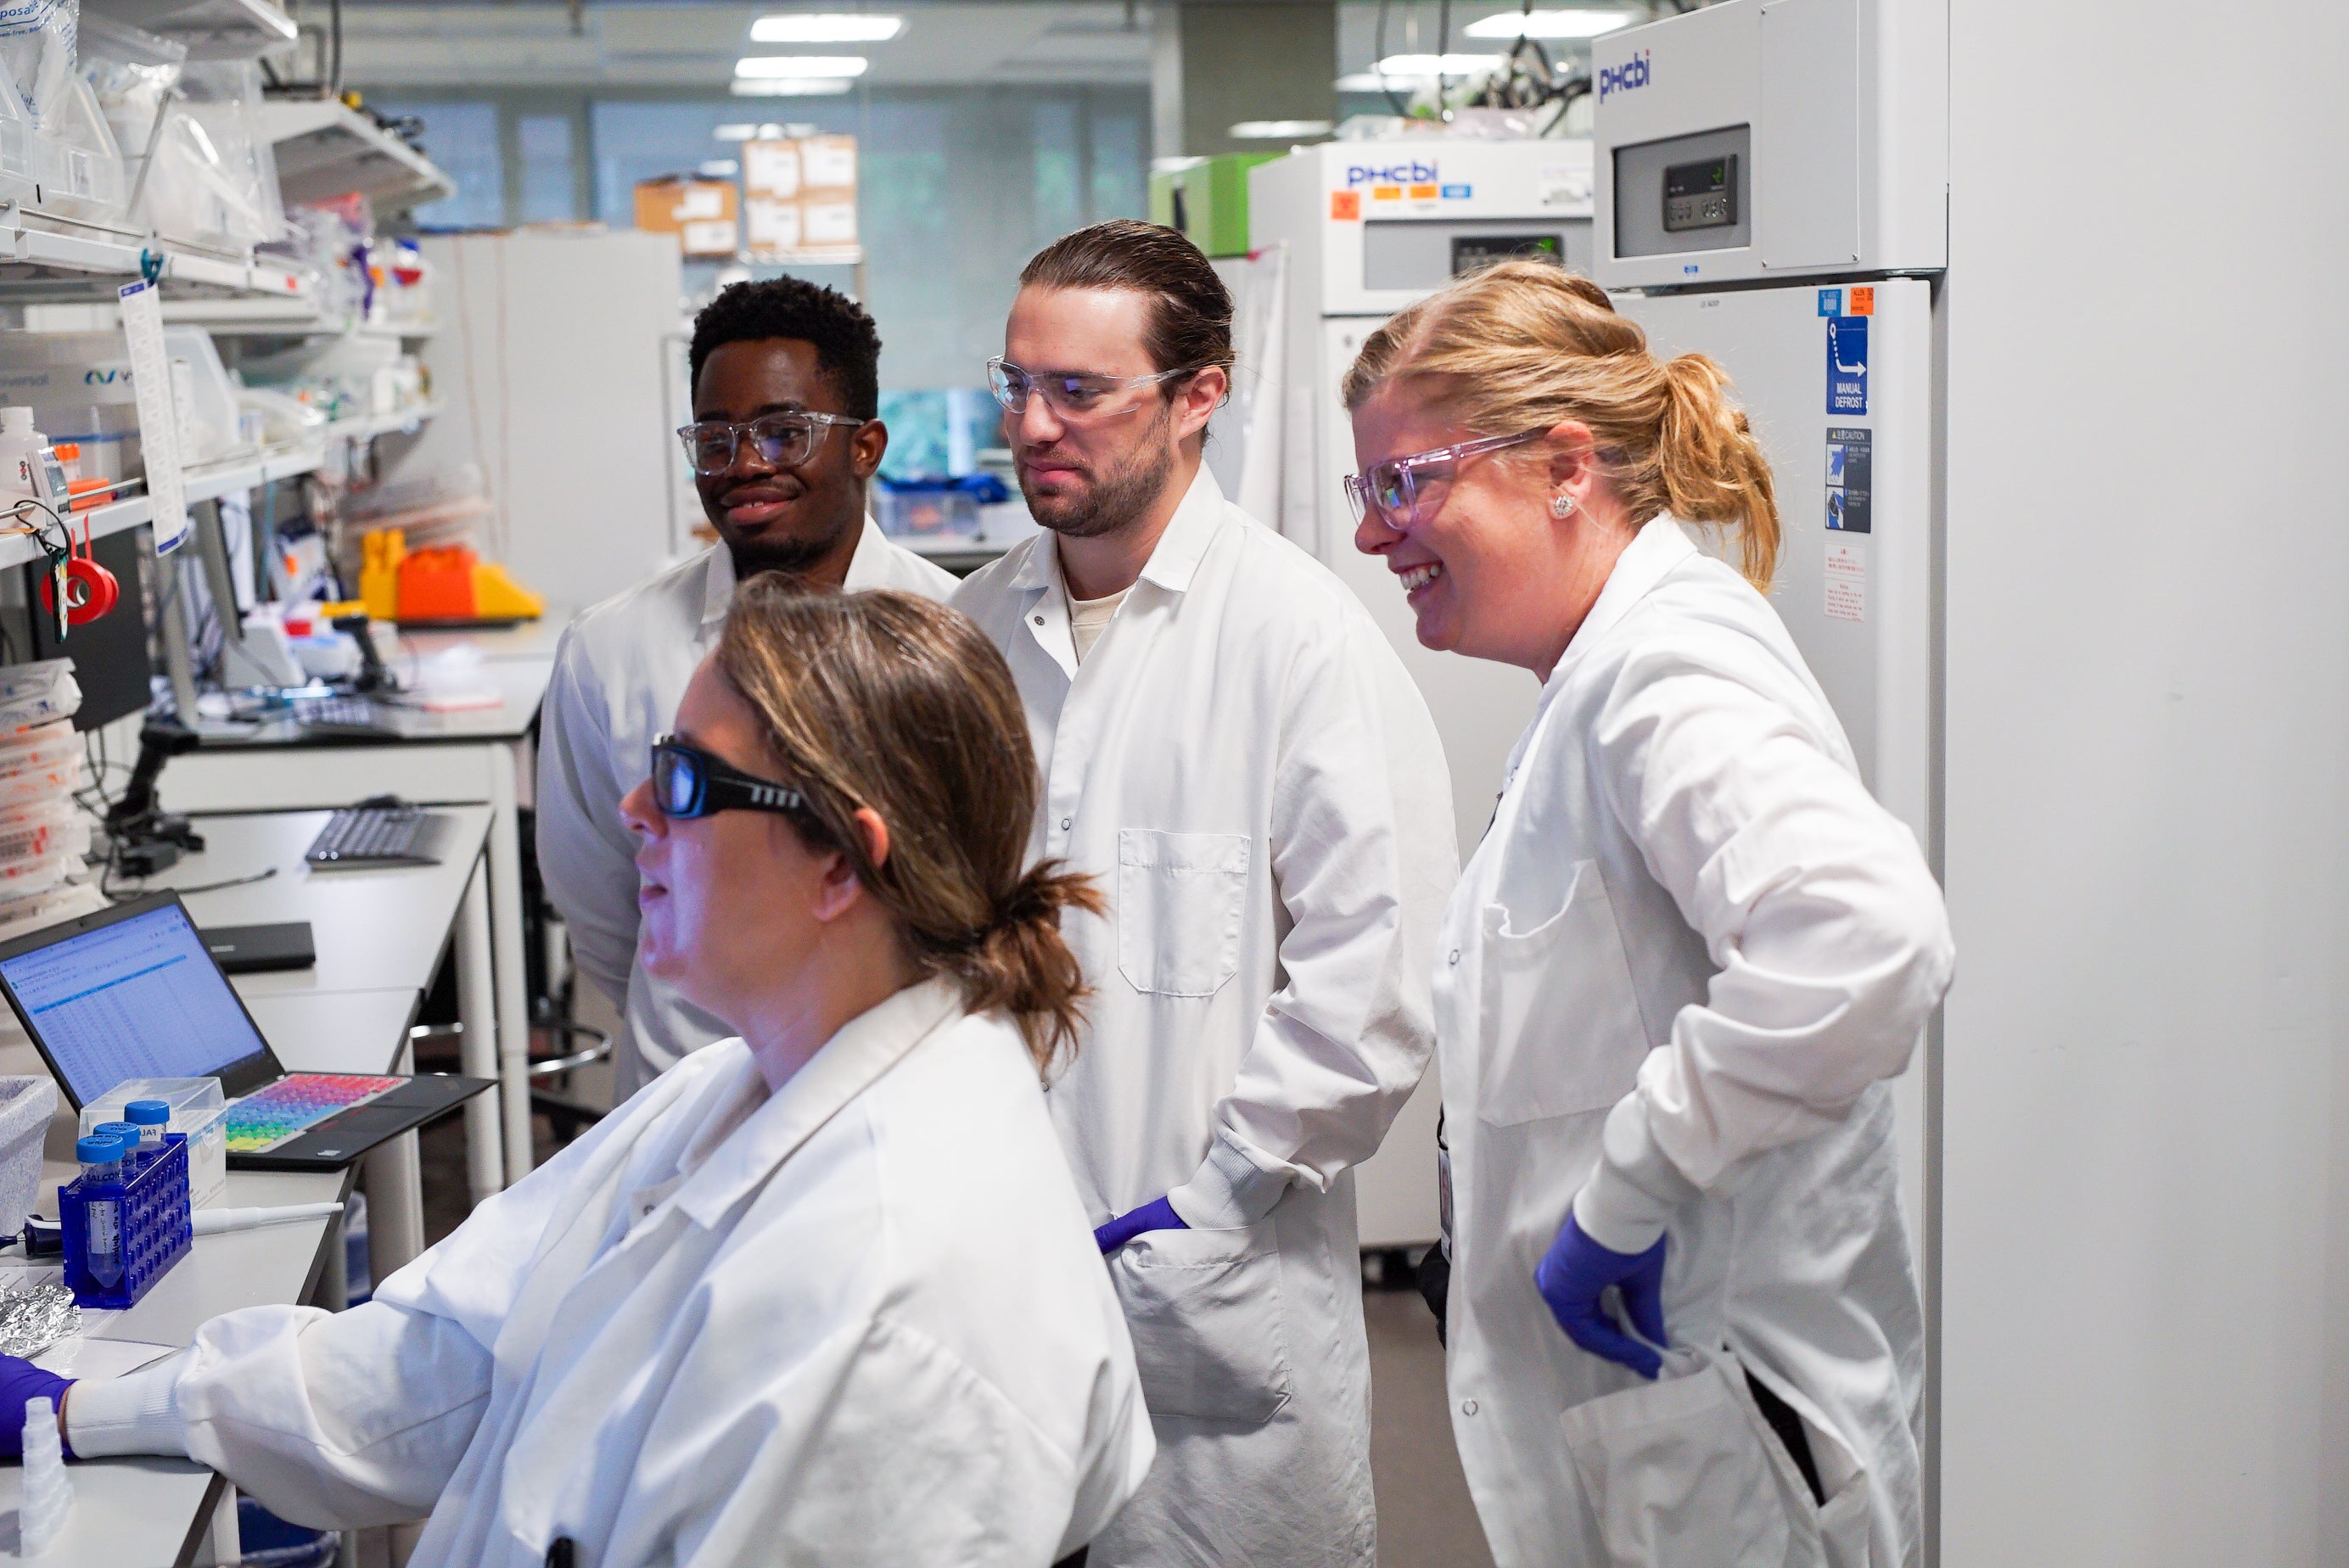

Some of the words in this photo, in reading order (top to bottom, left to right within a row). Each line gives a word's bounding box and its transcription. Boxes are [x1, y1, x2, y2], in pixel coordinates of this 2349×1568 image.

[1836, 382, 1863, 395] MANUAL
[1835, 396, 1864, 409] DEFROST
[1846, 430, 1865, 440] CAUTION
[87, 1172, 121, 1182] FALCON
